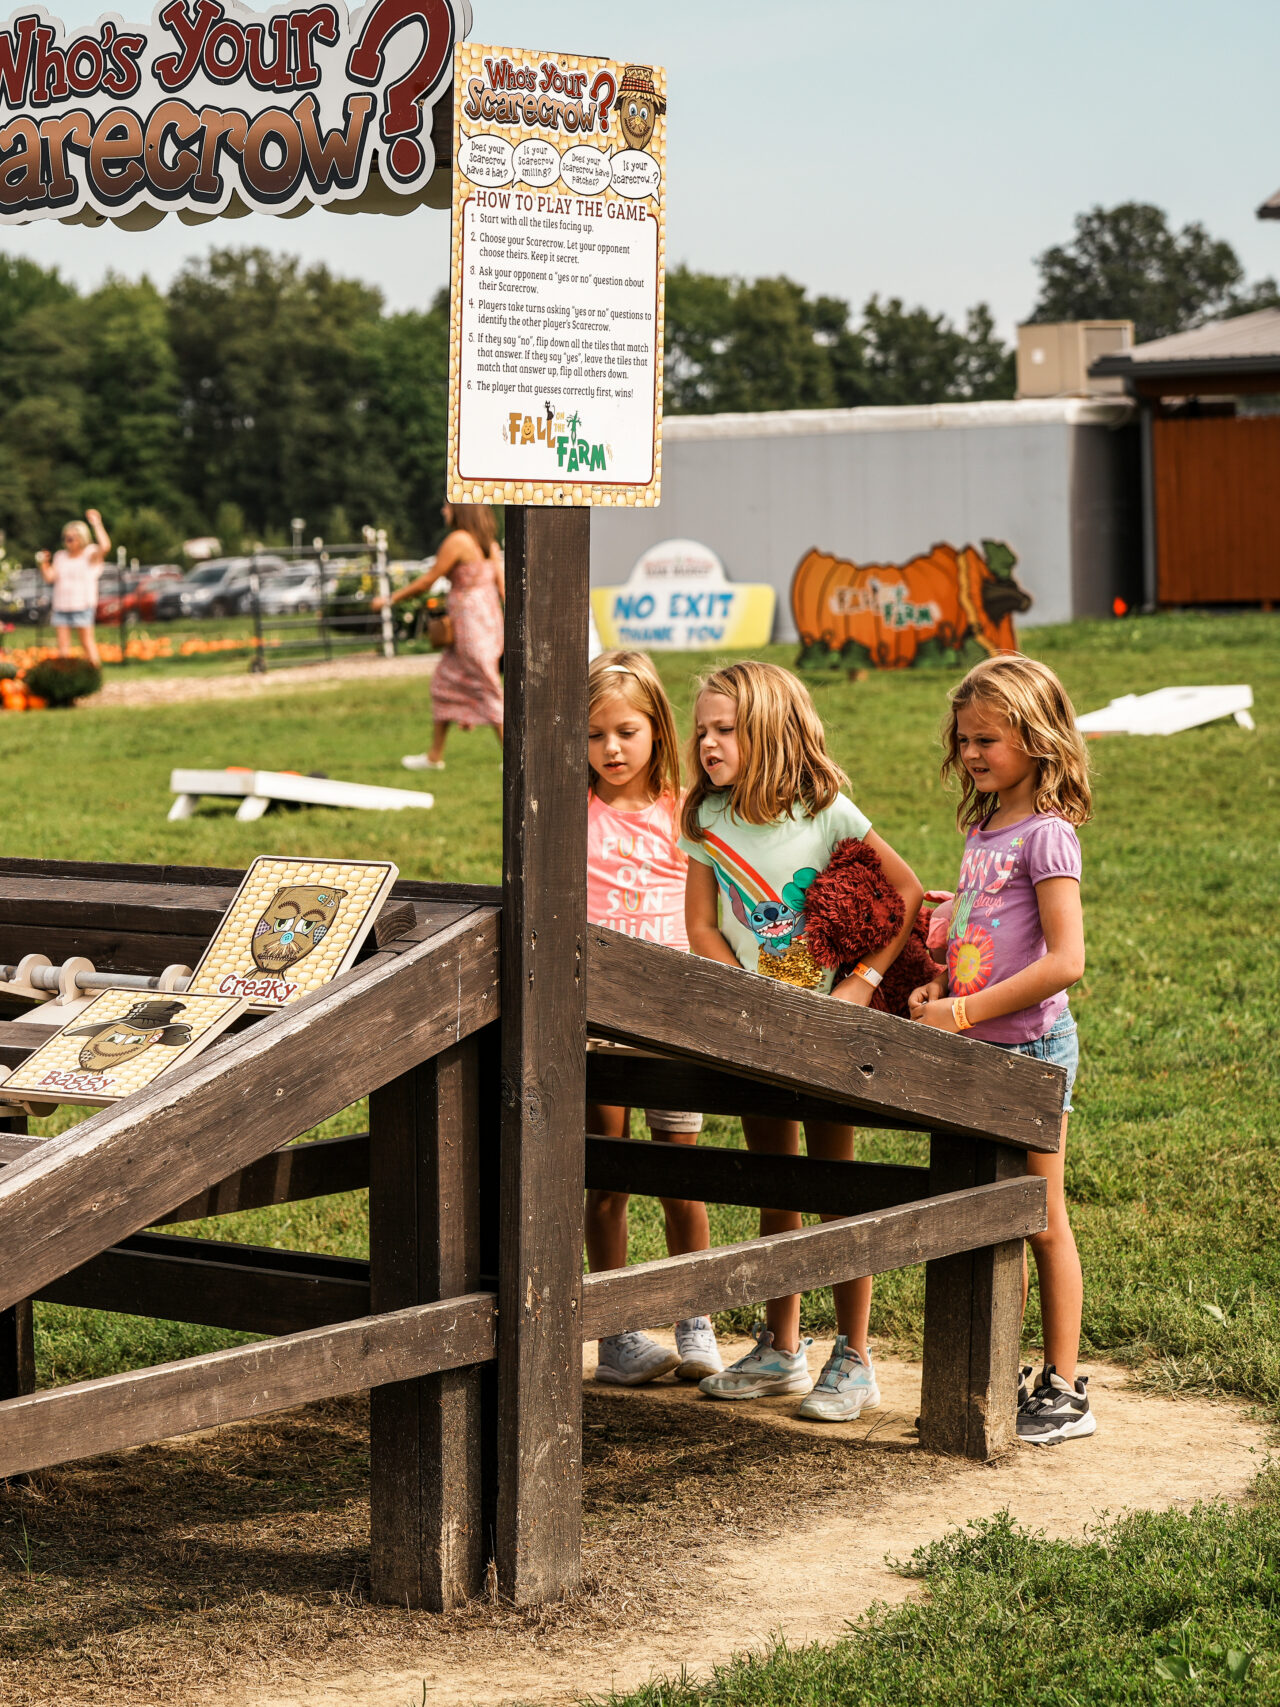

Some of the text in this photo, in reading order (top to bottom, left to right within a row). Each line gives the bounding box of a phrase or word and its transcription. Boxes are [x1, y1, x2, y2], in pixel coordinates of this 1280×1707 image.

[152, 0, 341, 88] Your
[484, 58, 538, 92] Who's
[486, 168, 490, 176] a
[476, 191, 646, 222] HOW TO PLAY THE GAME
[471, 214, 594, 233] 1. Start with all the tiles facing up.
[471, 232, 630, 255] 2. Choose your Scarecrow. Let your opponent
[479, 247, 579, 264] choose theirs. Keep it secret.
[470, 265, 475, 275] 3.
[479, 267, 492, 277] Ask
[494, 268, 512, 279] your
[513, 271, 547, 281] opponent
[593, 275, 623, 286] question
[625, 278, 644, 287] about
[479, 281, 539, 294] their Scarecrow.
[468, 299, 474, 309] 4.
[478, 300, 507, 311] Players
[508, 302, 524, 312] take
[526, 304, 545, 314] turns
[546, 305, 570, 317] asking
[588, 308, 596, 316] or
[610, 308, 643, 320] questions
[645, 312, 652, 321] to
[478, 314, 611, 332] identify the other player's Scarecrow.
[468, 333, 474, 343] 5.
[478, 333, 484, 343] If
[485, 334, 502, 346] they
[503, 337, 516, 347] say
[536, 337, 549, 348] flip
[550, 338, 569, 348] down
[571, 339, 580, 349] all
[581, 340, 593, 350] the
[594, 341, 609, 351] tiles
[610, 341, 625, 352] that
[627, 343, 648, 352] match
[478, 348, 493, 358] that
[494, 350, 523, 359] answer.
[525, 350, 530, 359] If
[531, 351, 548, 362] they
[549, 352, 562, 363] say
[584, 354, 603, 364] leave
[604, 356, 616, 365] the
[617, 356, 632, 366] tiles
[633, 357, 648, 367] that
[478, 363, 628, 379] match that answer up, flip all others down.
[467, 381, 633, 398] 6. The player that guesses correctly first, wins!
[509, 412, 555, 448] FALL
[554, 423, 565, 433] THE
[557, 436, 606, 472] FARM
[614, 593, 734, 620] NO EXIT
[602, 835, 669, 861] FULL
[218, 974, 298, 1001] Creaky
[38, 1070, 116, 1092] Baggy
